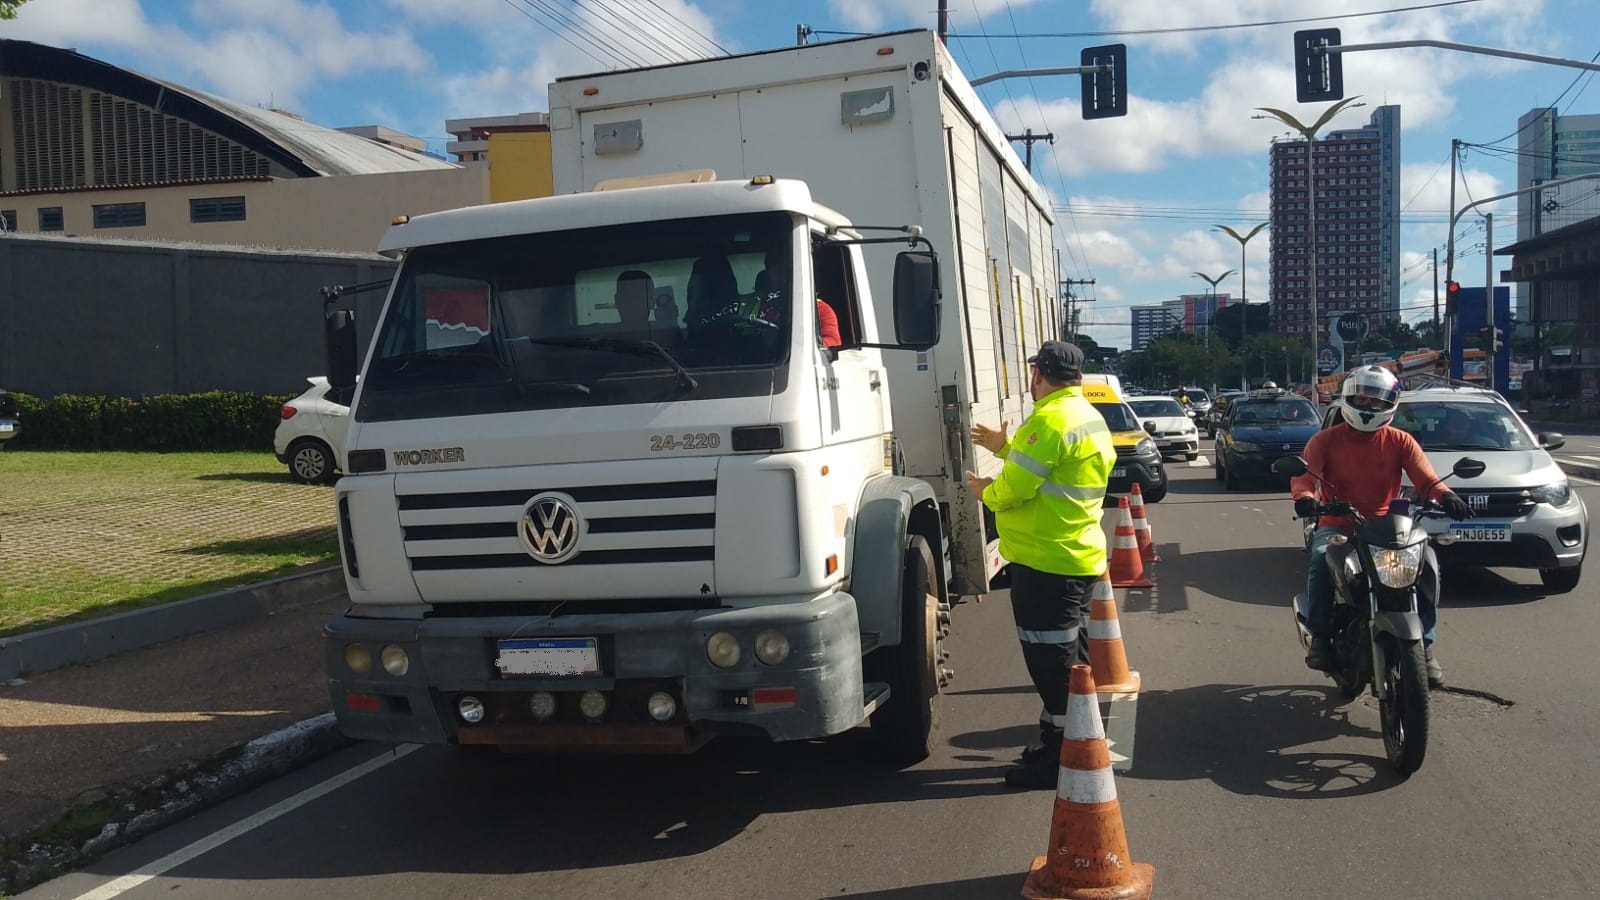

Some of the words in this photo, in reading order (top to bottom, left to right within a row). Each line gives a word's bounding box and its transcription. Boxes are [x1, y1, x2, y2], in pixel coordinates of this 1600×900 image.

[650, 432, 721, 452] 24-220
[393, 446, 465, 466] WORKER
[1468, 494, 1490, 510] FIAT
